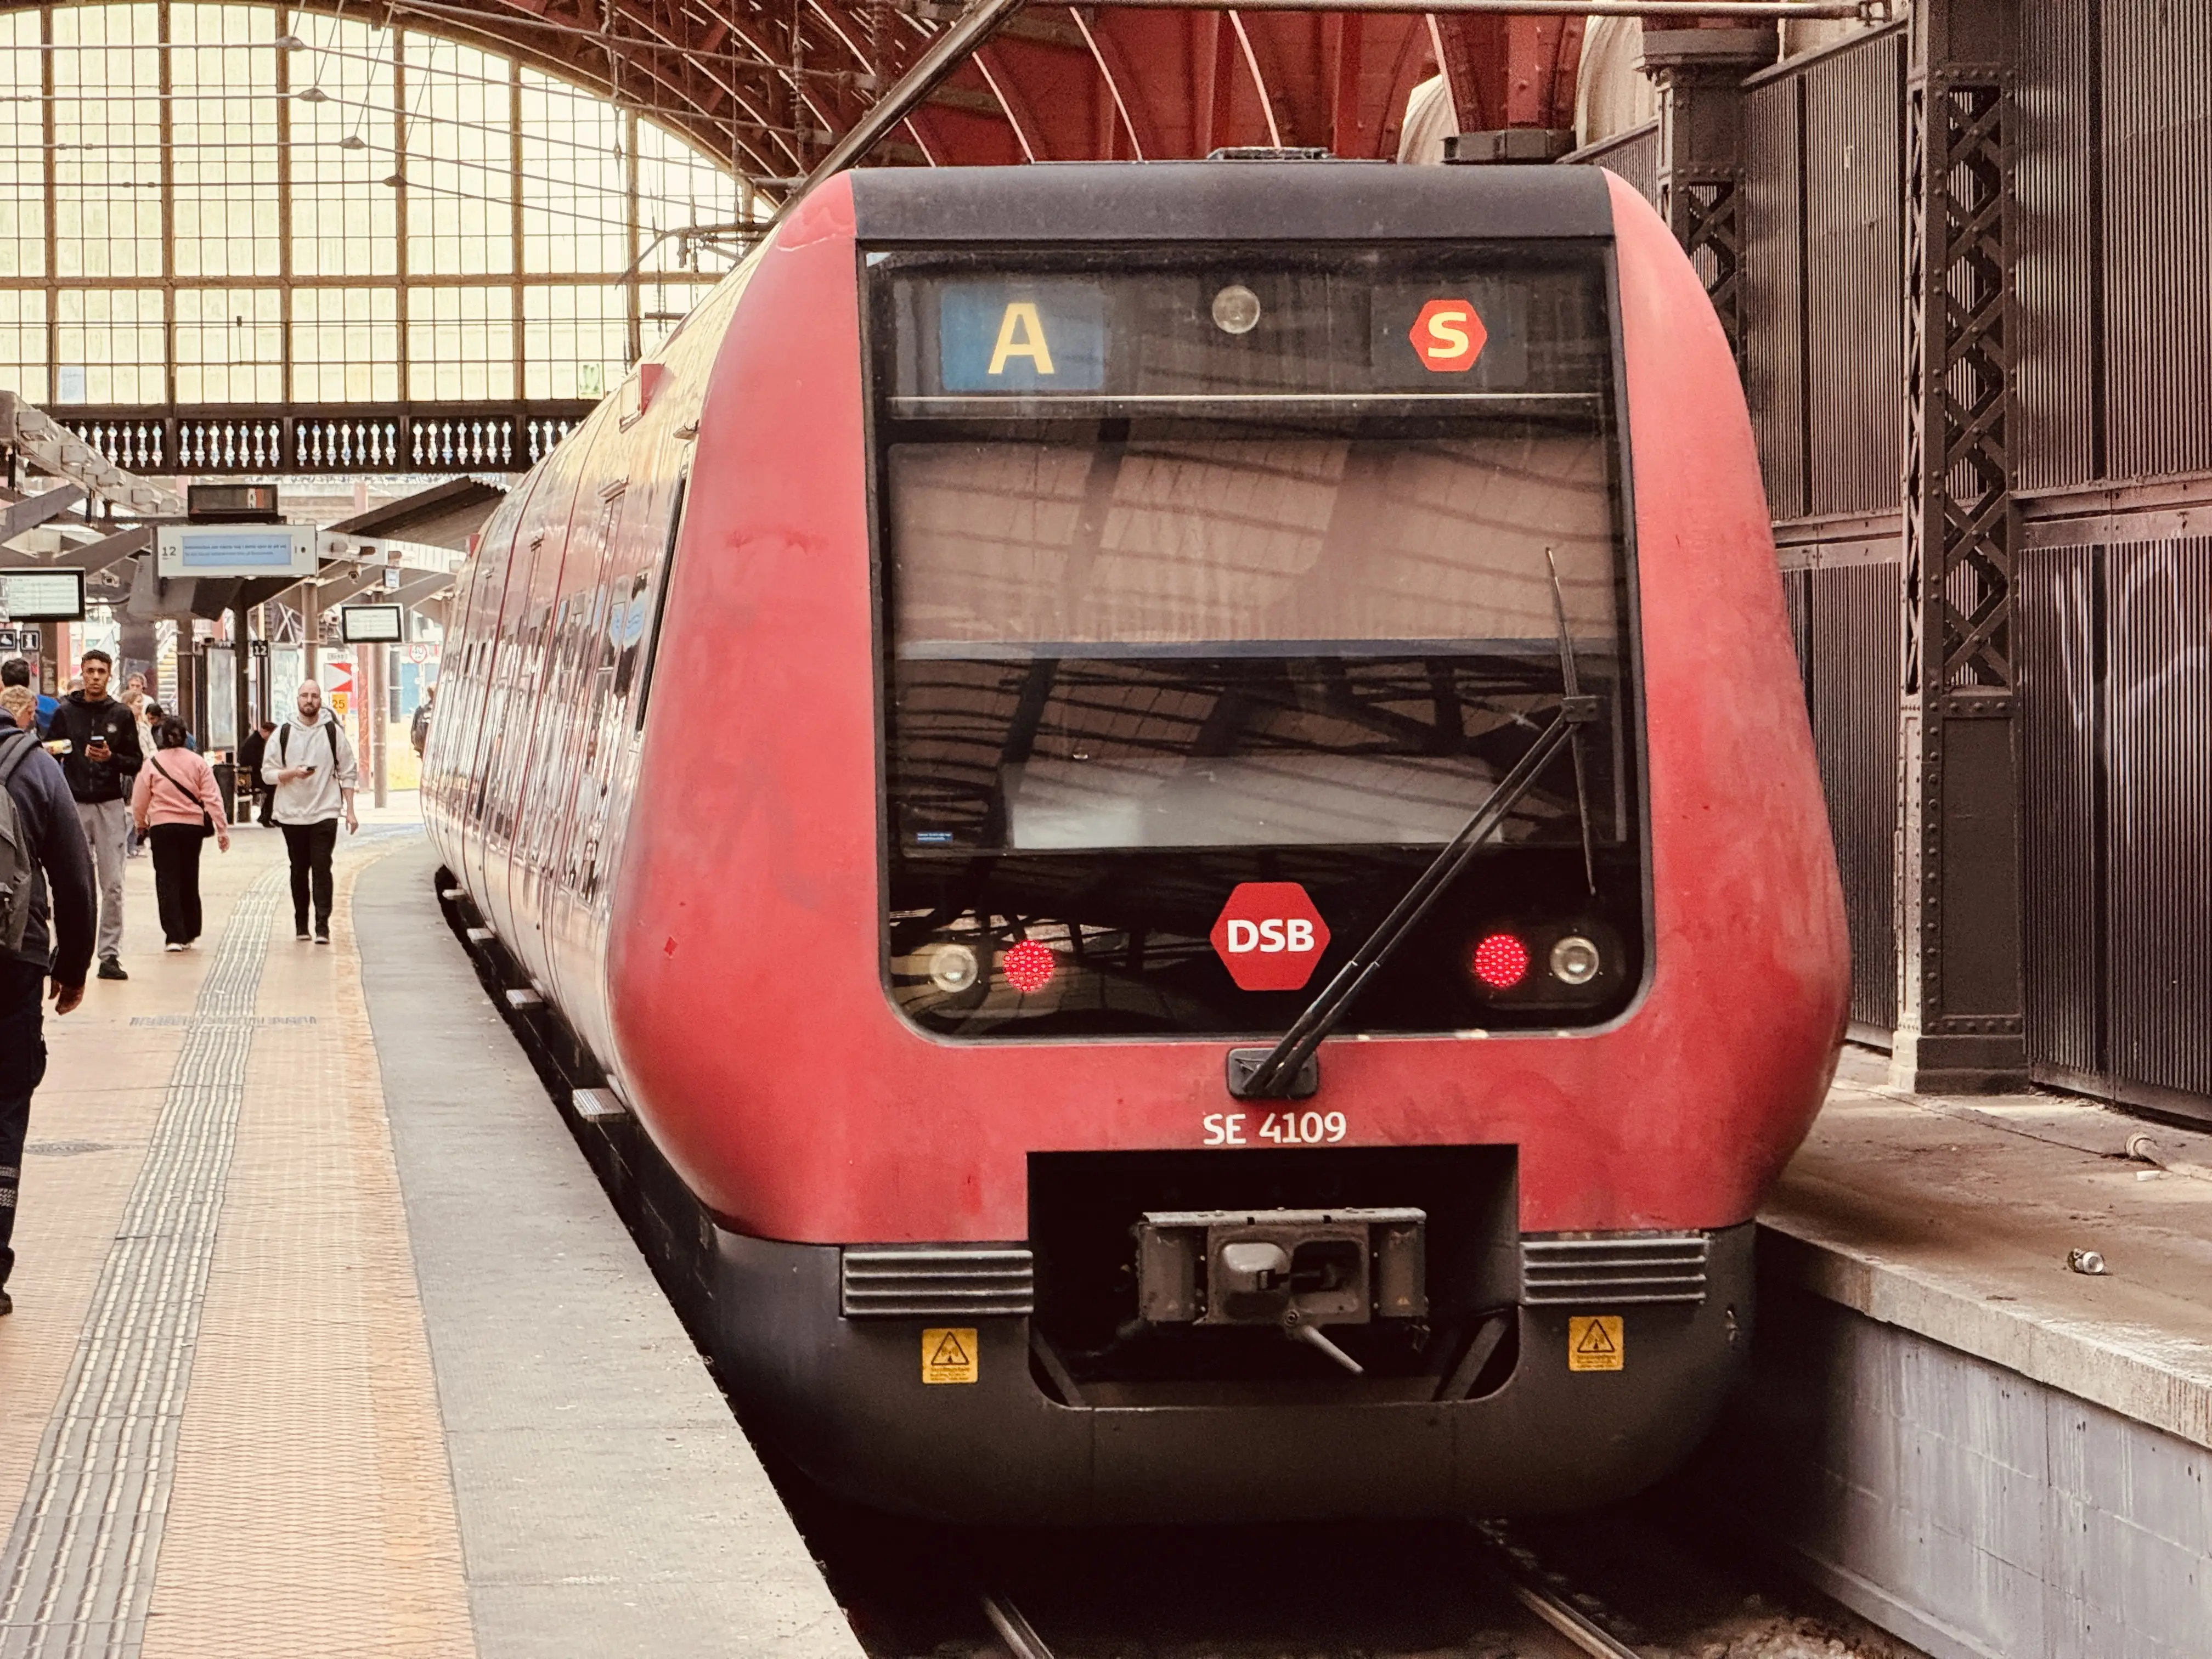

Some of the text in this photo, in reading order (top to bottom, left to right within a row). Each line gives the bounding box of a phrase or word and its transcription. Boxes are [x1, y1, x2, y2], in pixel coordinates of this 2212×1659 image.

[988, 302, 1056, 375] A
[1426, 311, 1470, 359] S
[161, 546, 177, 556] 12
[254, 645, 267, 656] 12
[332, 699, 346, 709] 25
[1227, 918, 1315, 953] DSB
[1203, 1111, 1347, 1145] SE 4109
